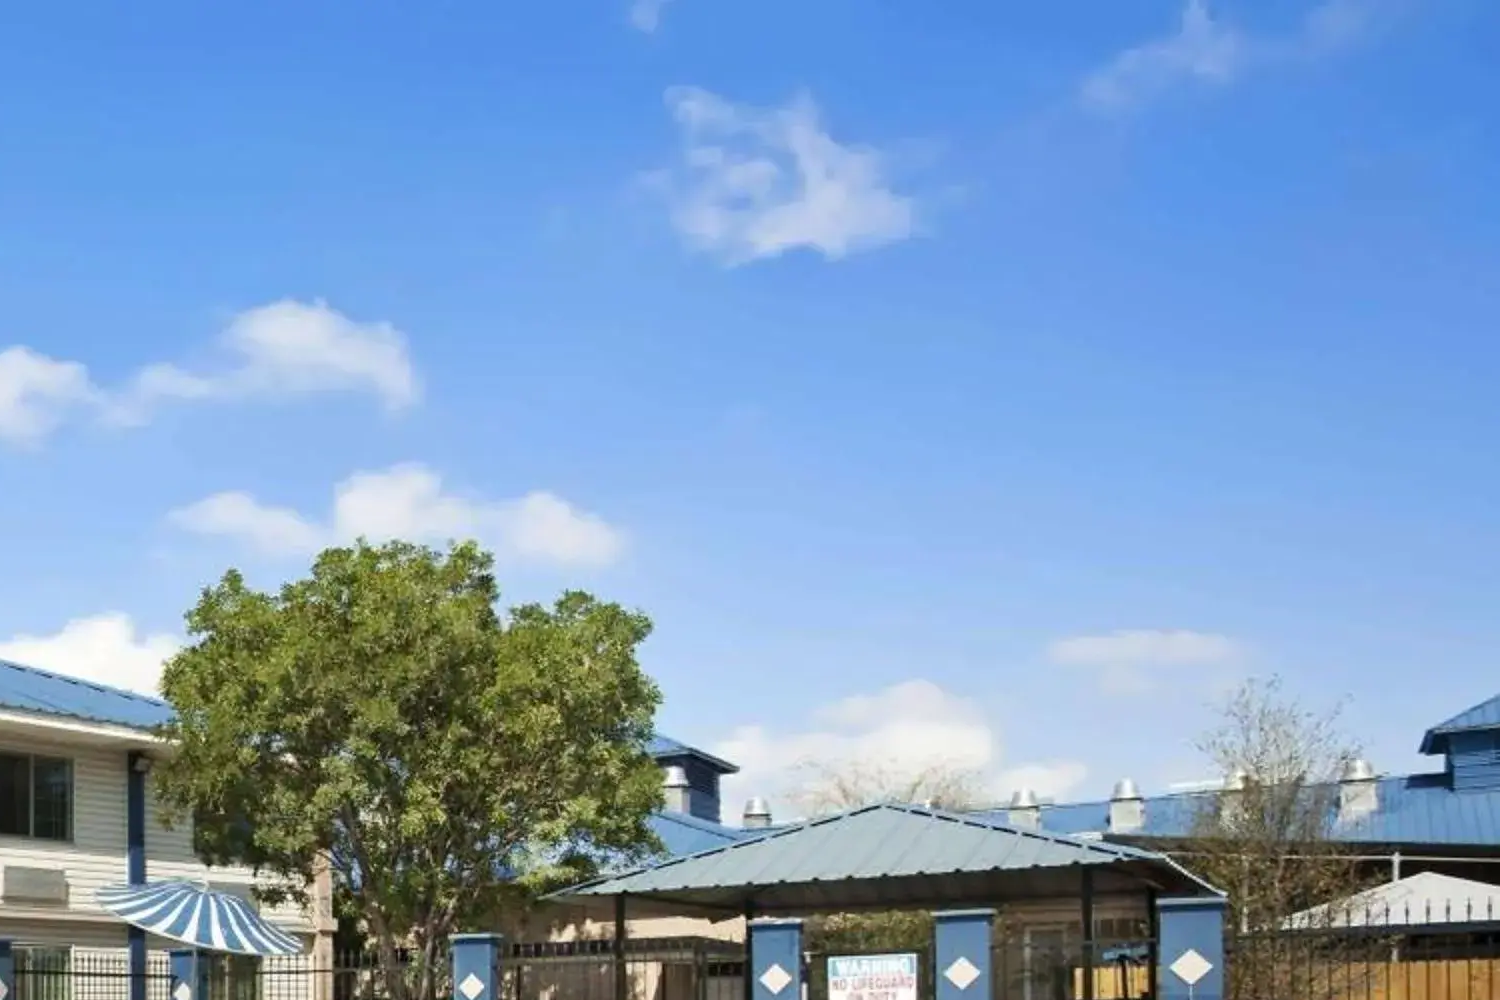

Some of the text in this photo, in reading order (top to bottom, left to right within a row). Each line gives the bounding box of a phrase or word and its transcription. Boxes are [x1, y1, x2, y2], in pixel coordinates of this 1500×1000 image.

[835, 958, 910, 976] WARNING
[832, 977, 914, 990] NO LIFEGUARD
